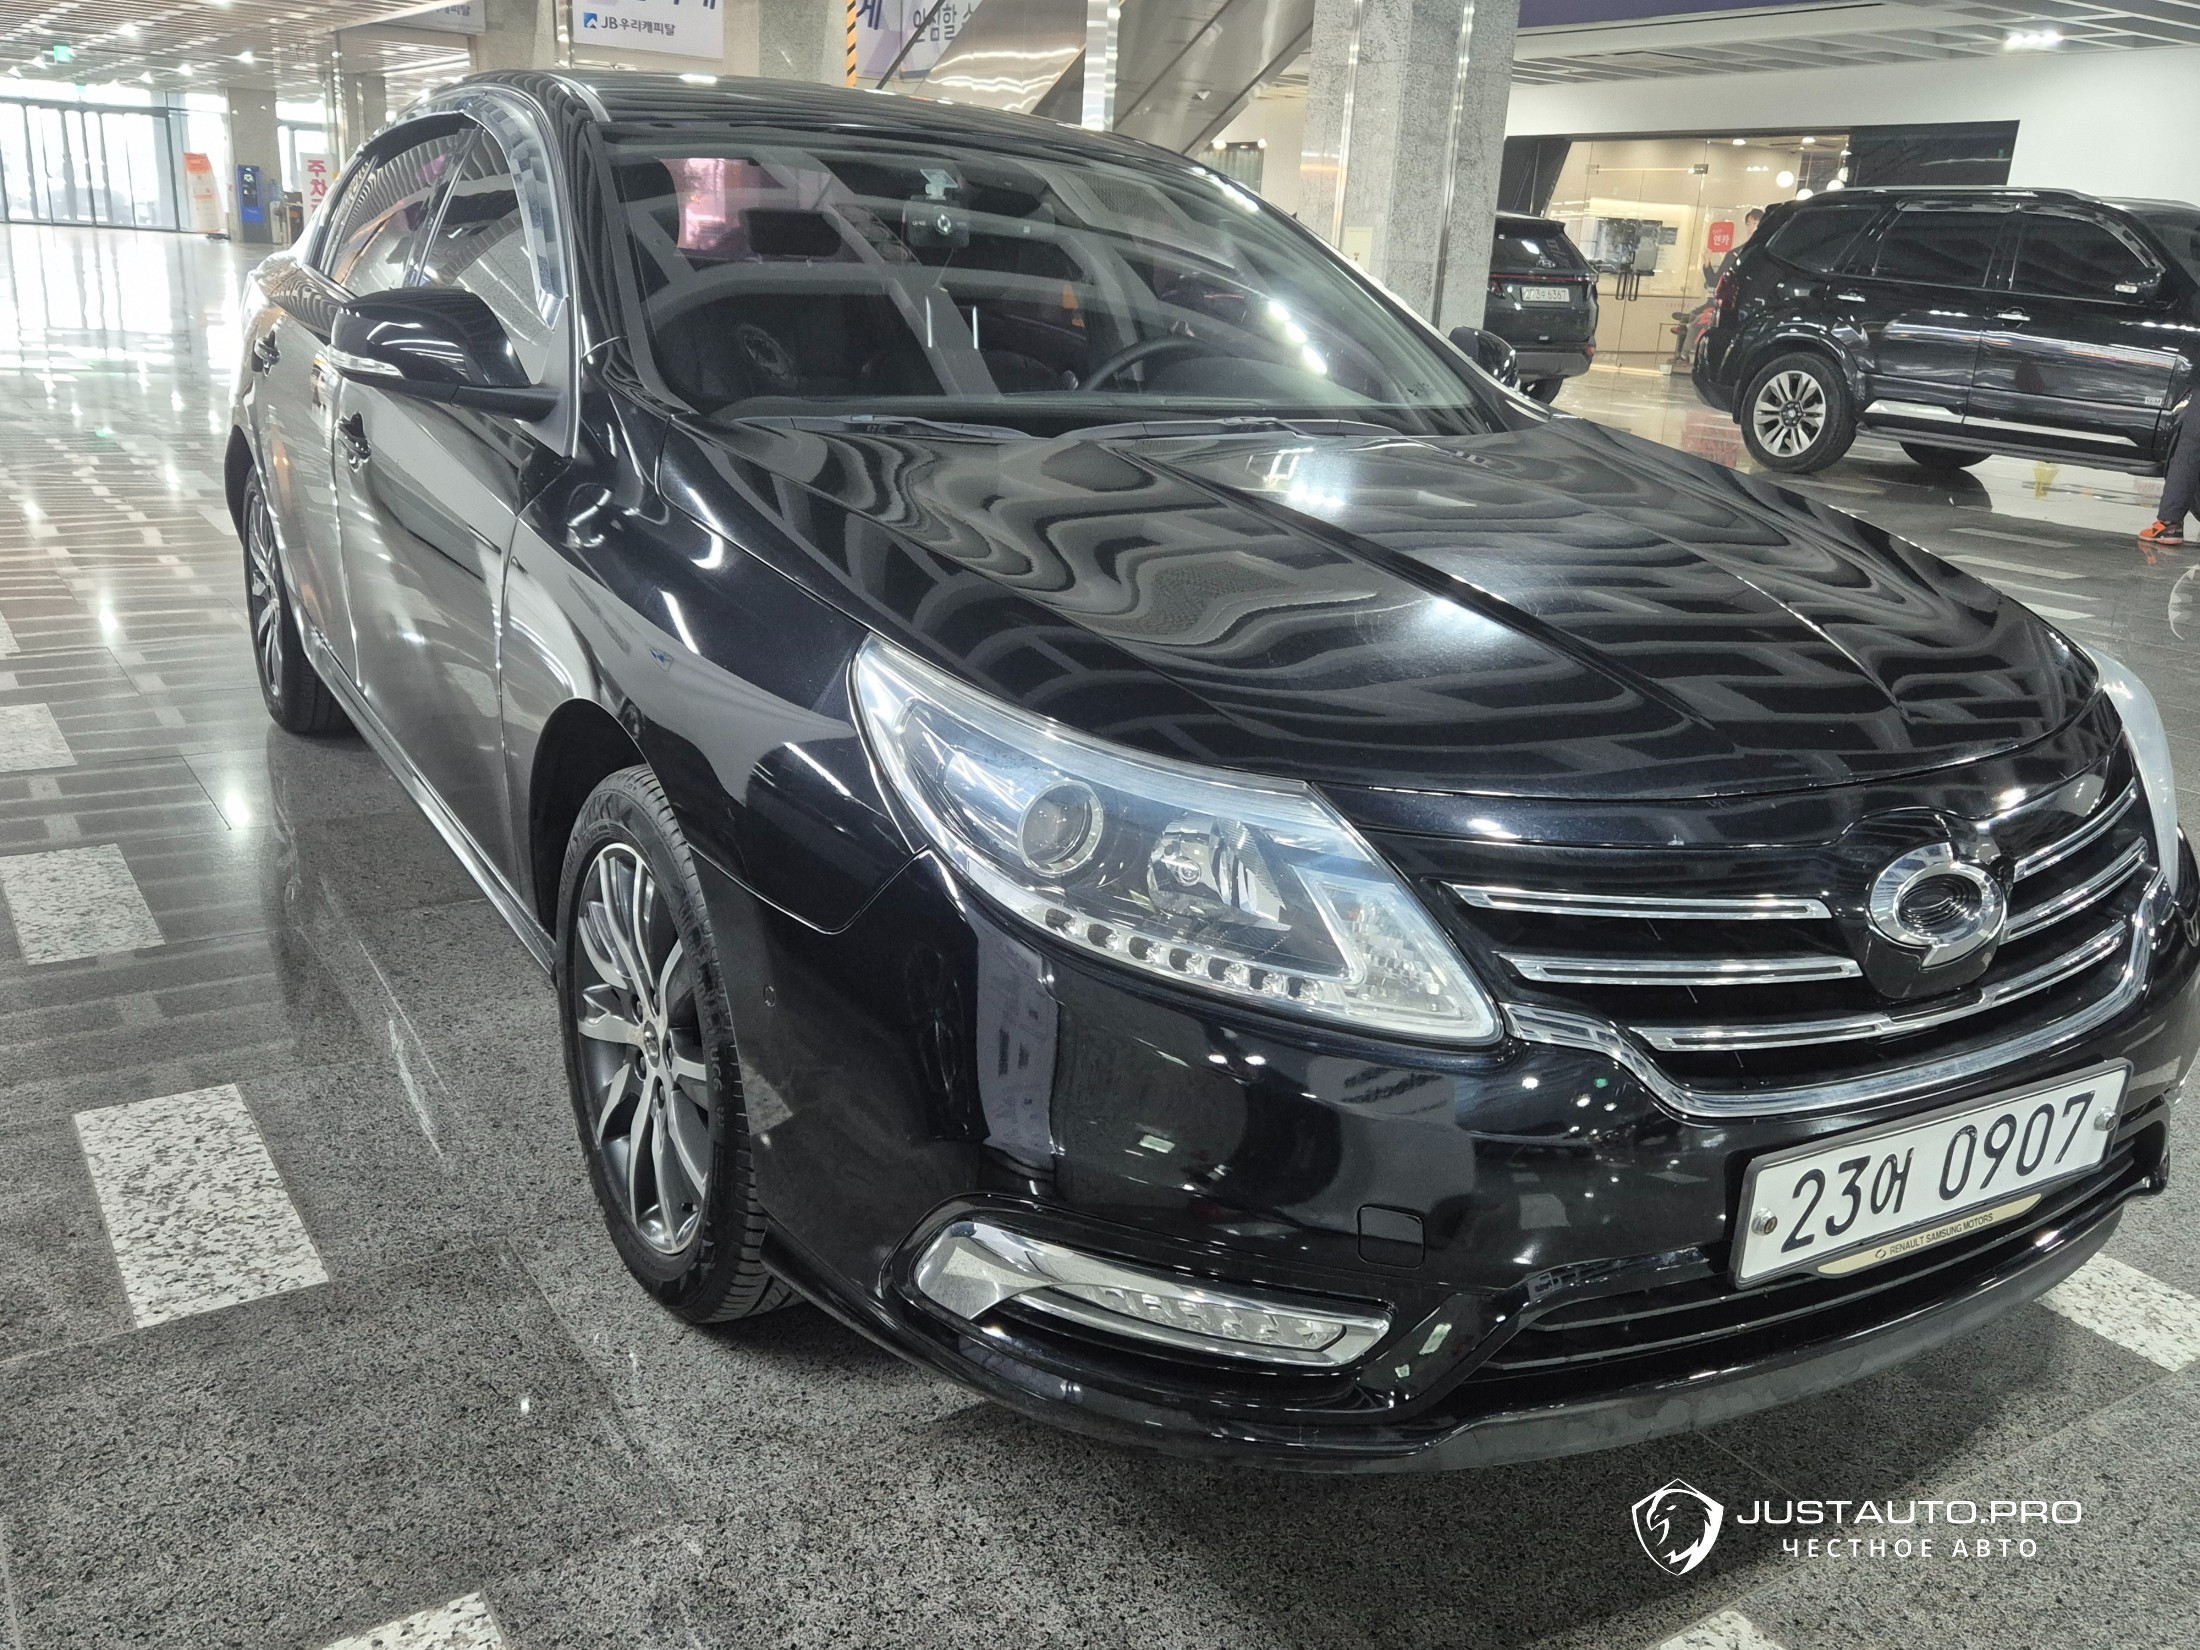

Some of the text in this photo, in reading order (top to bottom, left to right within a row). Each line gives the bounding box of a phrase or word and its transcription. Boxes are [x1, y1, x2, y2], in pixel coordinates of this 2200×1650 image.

[600, 16, 676, 37] JB우리캐피탈
[1780, 1090, 2095, 1253] 23어 0907
[1889, 1212, 1994, 1255] RENAULT SAMSUNG MOTORS
